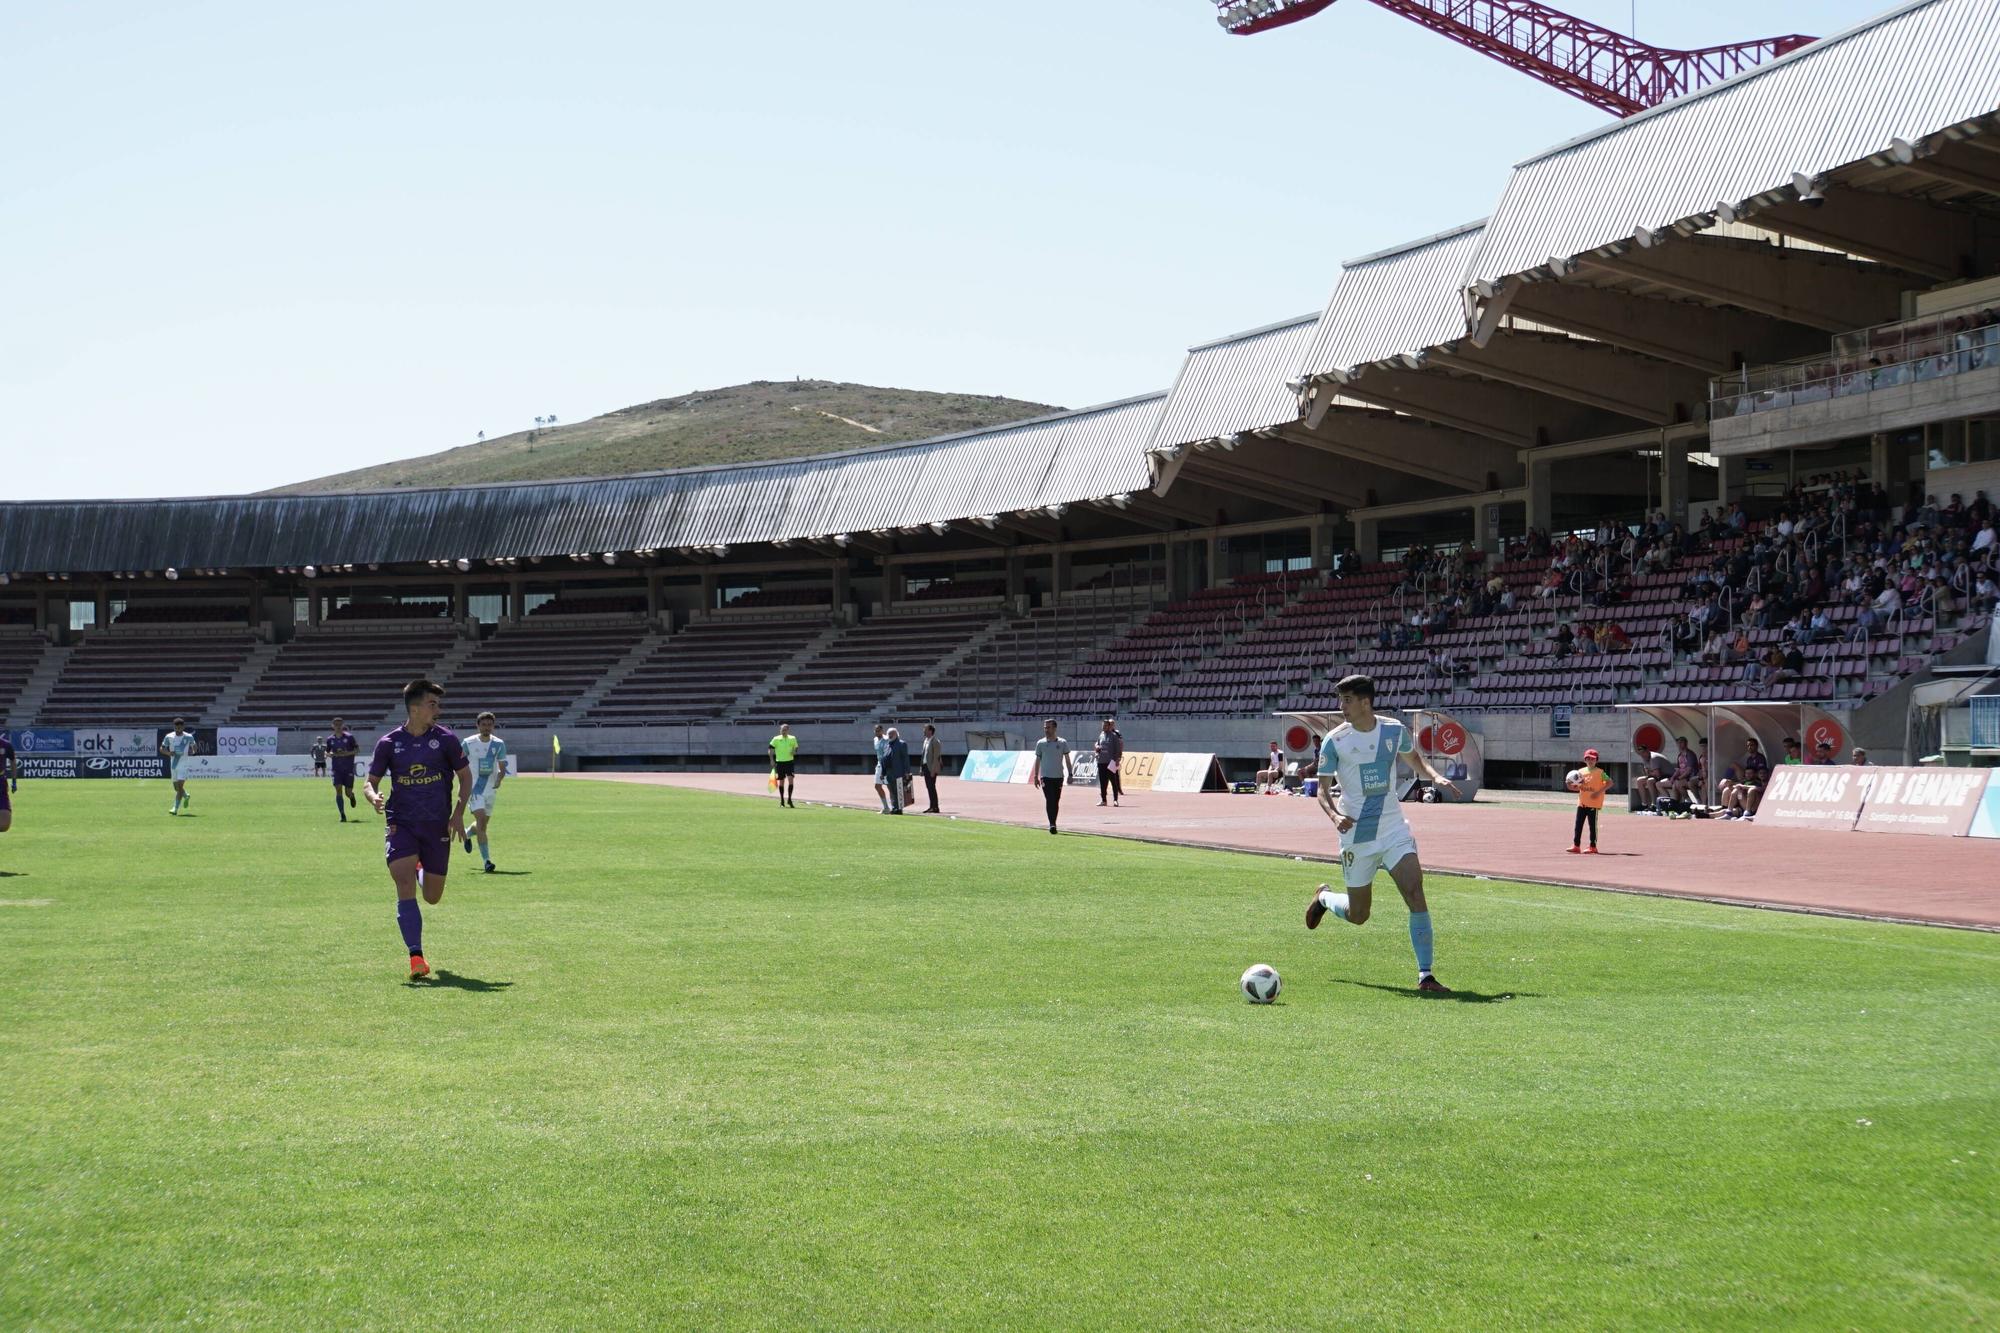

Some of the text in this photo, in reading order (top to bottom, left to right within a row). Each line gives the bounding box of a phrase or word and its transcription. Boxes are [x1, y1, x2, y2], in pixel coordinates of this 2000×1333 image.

[83, 733, 114, 750] akt
[218, 732, 277, 753] agadea
[23, 759, 77, 768] HYUNDAI
[111, 759, 163, 768] HYUNDAI
[23, 768, 76, 777] HYUPERSA
[111, 768, 163, 777] HYUPERSA
[1363, 774, 1379, 782] San
[1364, 779, 1387, 790] Rafael
[1767, 771, 1793, 801] 24
[1787, 772, 1851, 802] HORAS
[1874, 773, 1905, 804] DE
